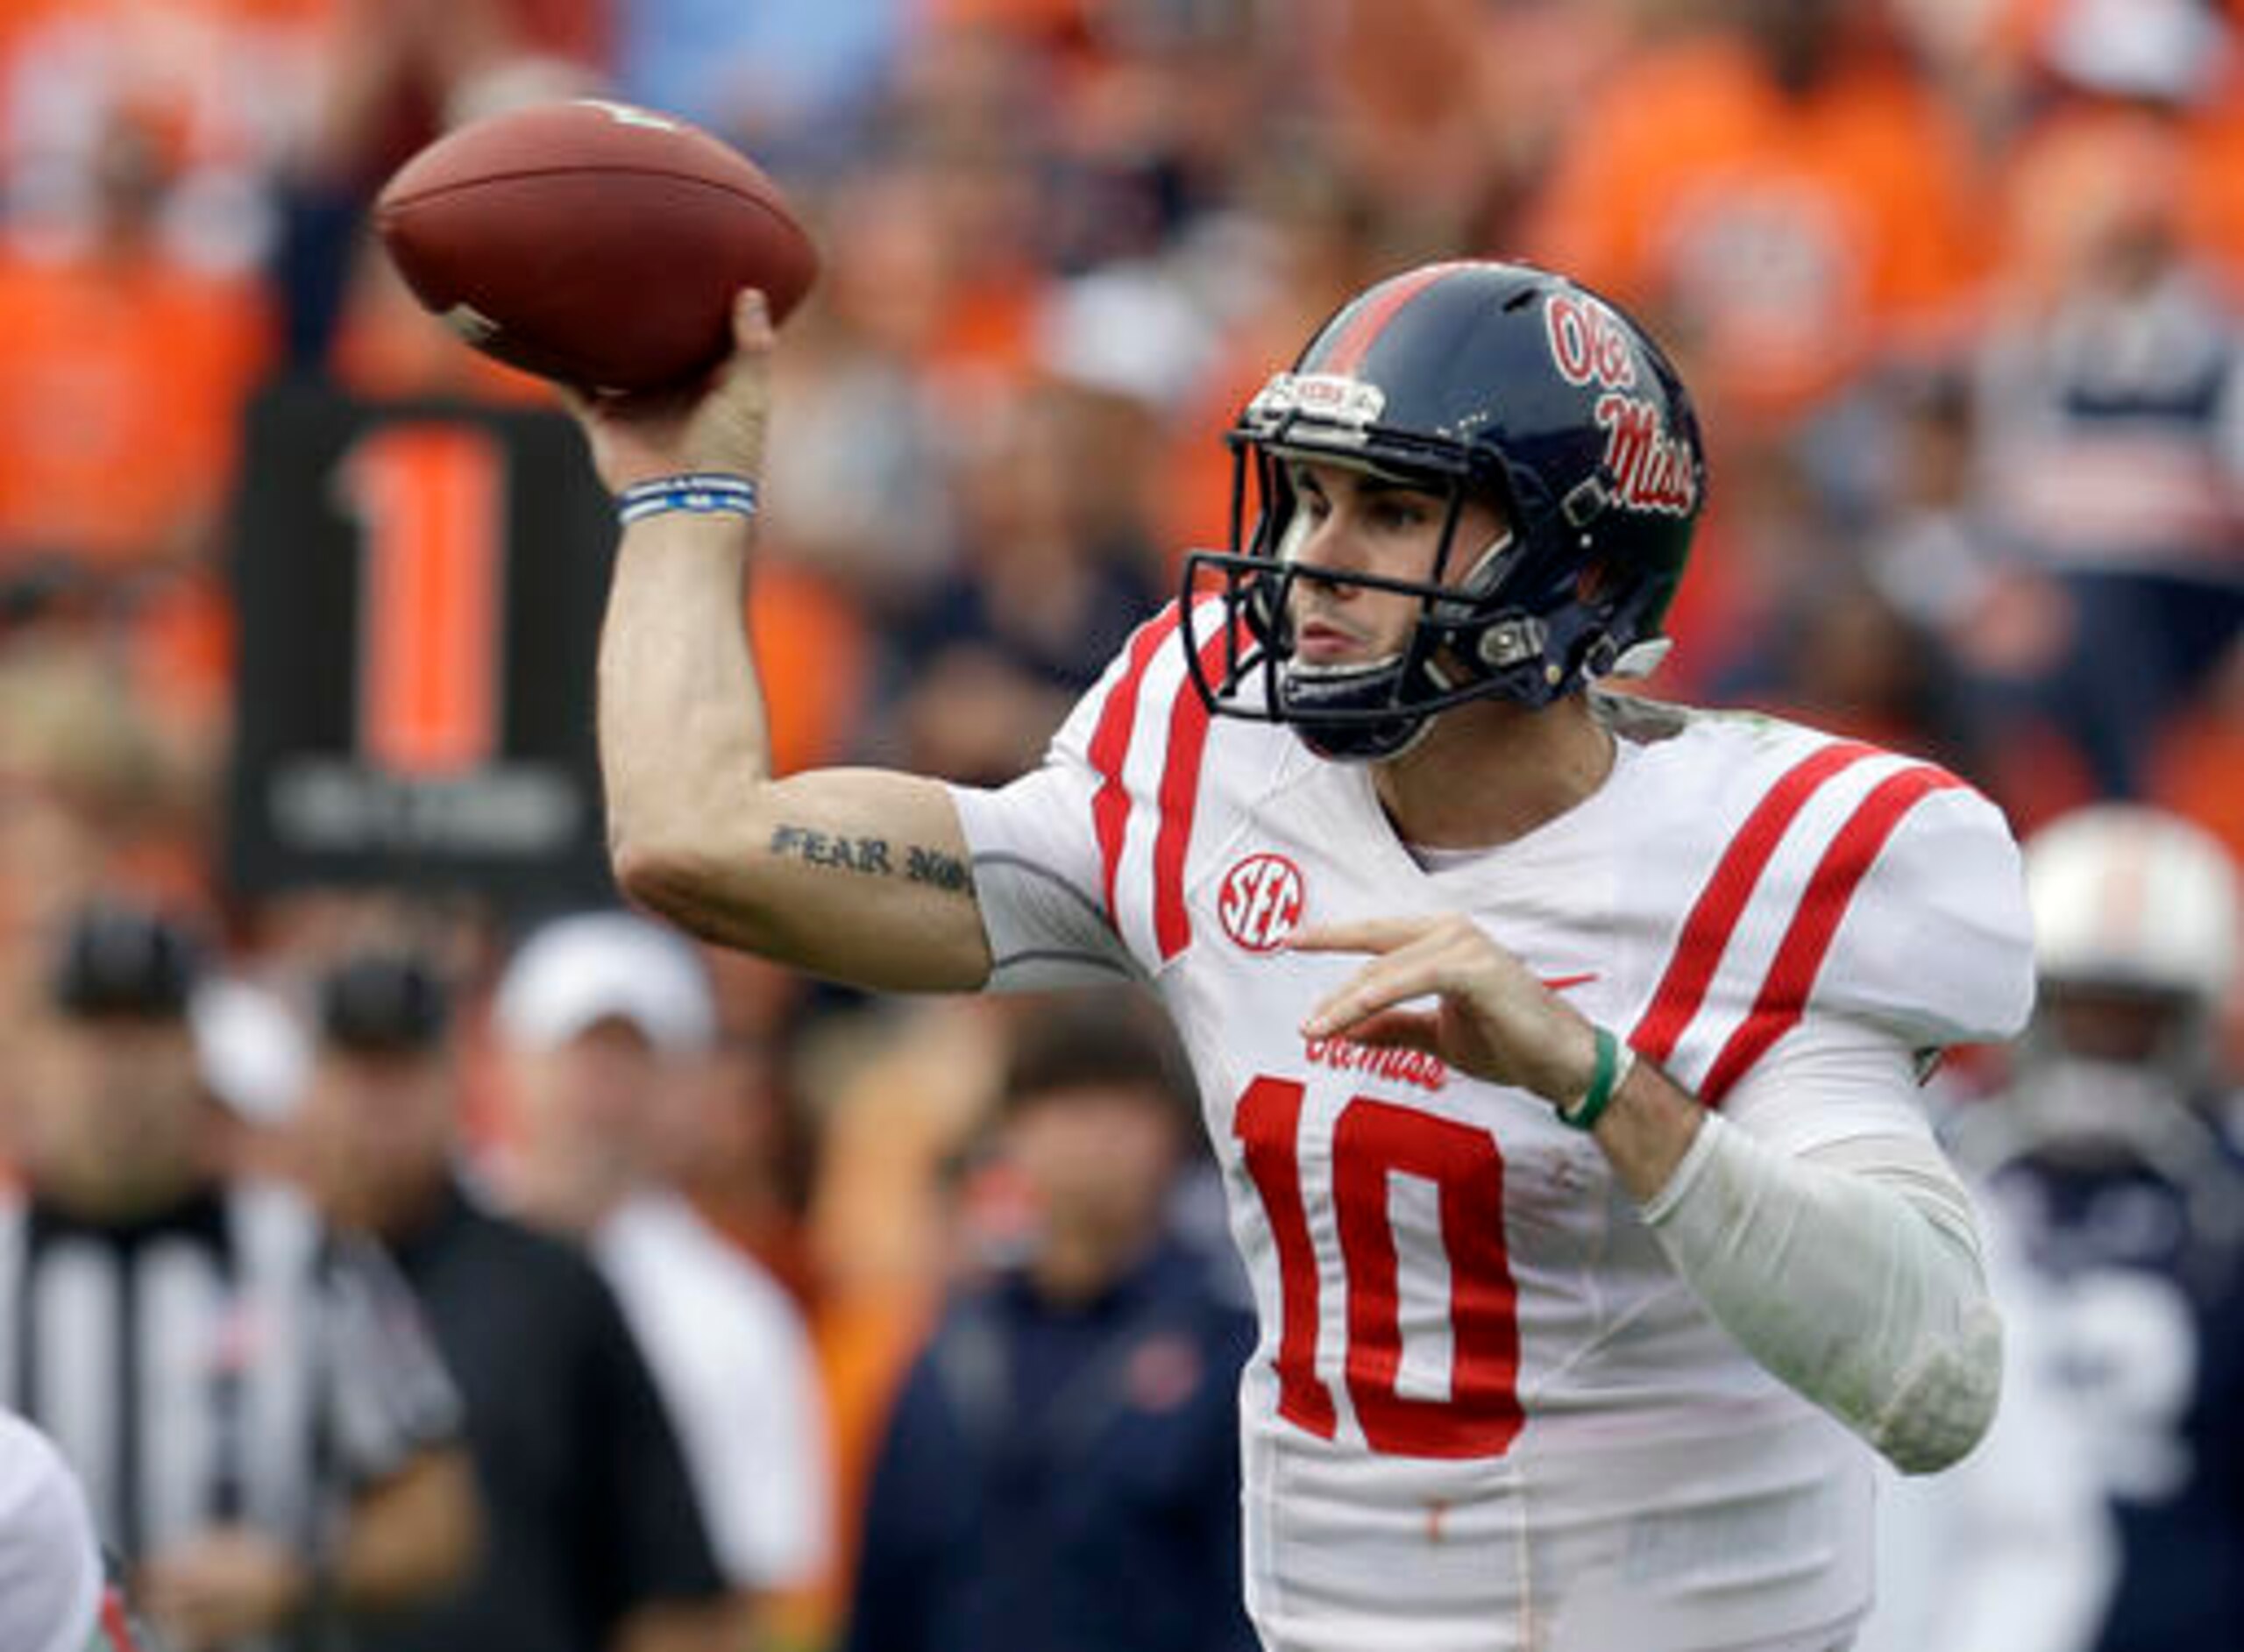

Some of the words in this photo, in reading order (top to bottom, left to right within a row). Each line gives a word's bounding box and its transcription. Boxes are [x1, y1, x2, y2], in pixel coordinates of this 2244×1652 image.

[1545, 296, 1634, 386] Ole
[1595, 394, 1694, 517] Miss
[326, 423, 507, 778] 1
[770, 825, 892, 875] FEAR
[1223, 860, 1301, 948] SEC
[1232, 1074, 1526, 1461] 10
